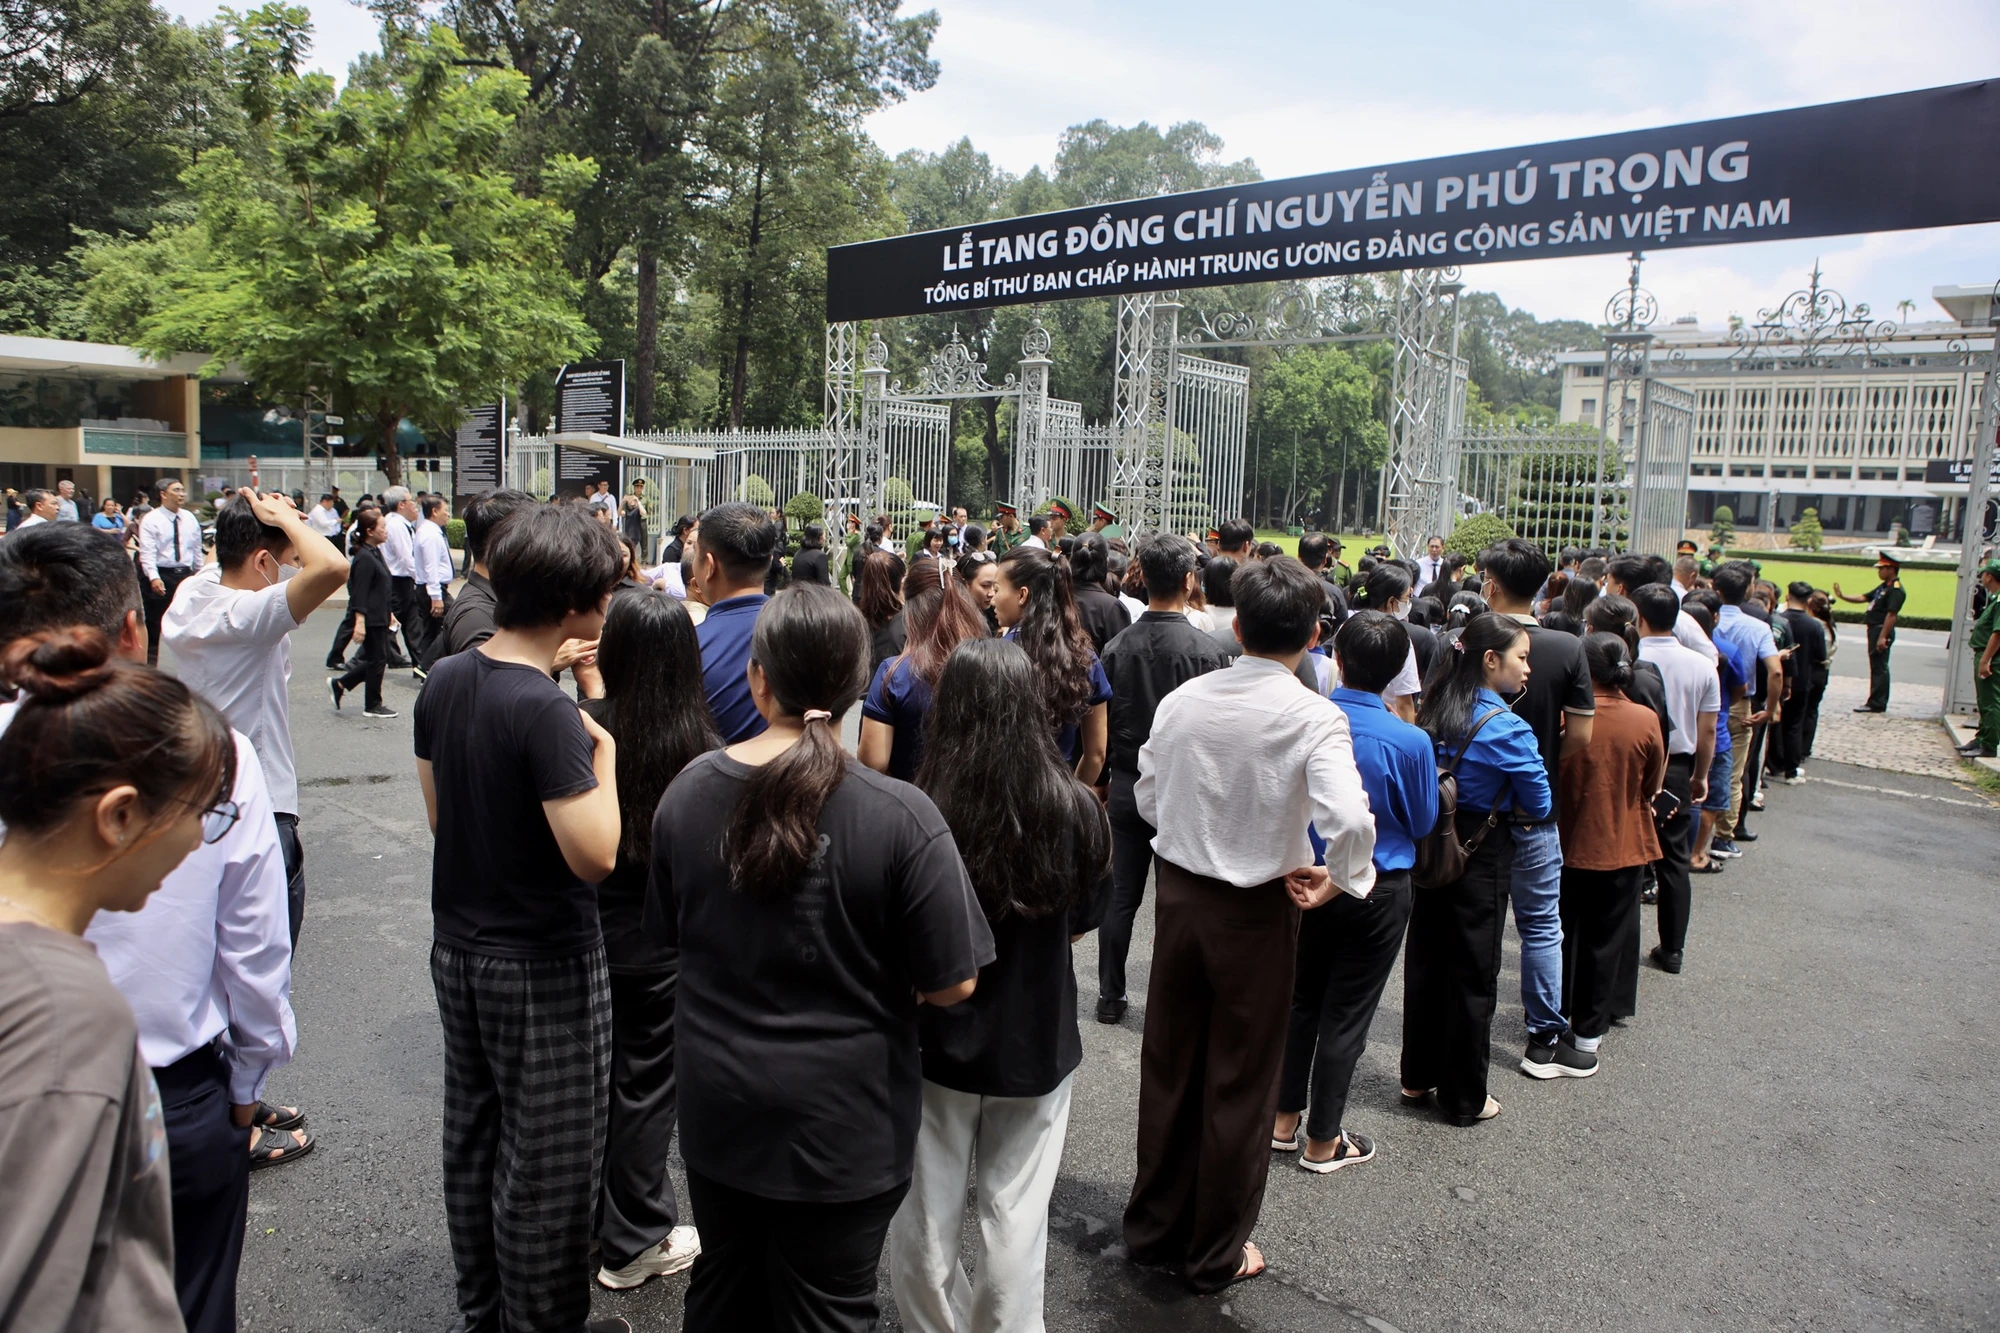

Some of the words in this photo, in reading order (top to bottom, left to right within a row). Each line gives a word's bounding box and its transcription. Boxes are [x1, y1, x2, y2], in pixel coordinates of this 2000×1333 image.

[924, 280, 970, 304] TỔNG
[973, 277, 991, 299] BÍ
[992, 273, 1031, 297] THƯ
[1033, 271, 1072, 292] BAN
[1075, 260, 1129, 287] CHẤP
[1134, 255, 1196, 281] HÀNH
[1200, 249, 1279, 275] TRUNG
[1286, 240, 1361, 267] ƯƠNG
[1366, 229, 1447, 260] ĐẢNG
[1454, 223, 1540, 257] CỘNG
[1548, 211, 1613, 244] SẢN
[1620, 205, 1696, 242] VIỆT
[1703, 198, 1791, 231] NAM
[943, 231, 973, 271] LỄ
[979, 230, 1057, 267] TANG
[1065, 213, 1164, 256] ĐỒNG
[1174, 198, 1239, 242] CHÍ
[1246, 171, 1424, 235] NGUYỄN
[1436, 159, 1538, 214] PHÚ
[1549, 141, 1750, 204] TRỌNG
